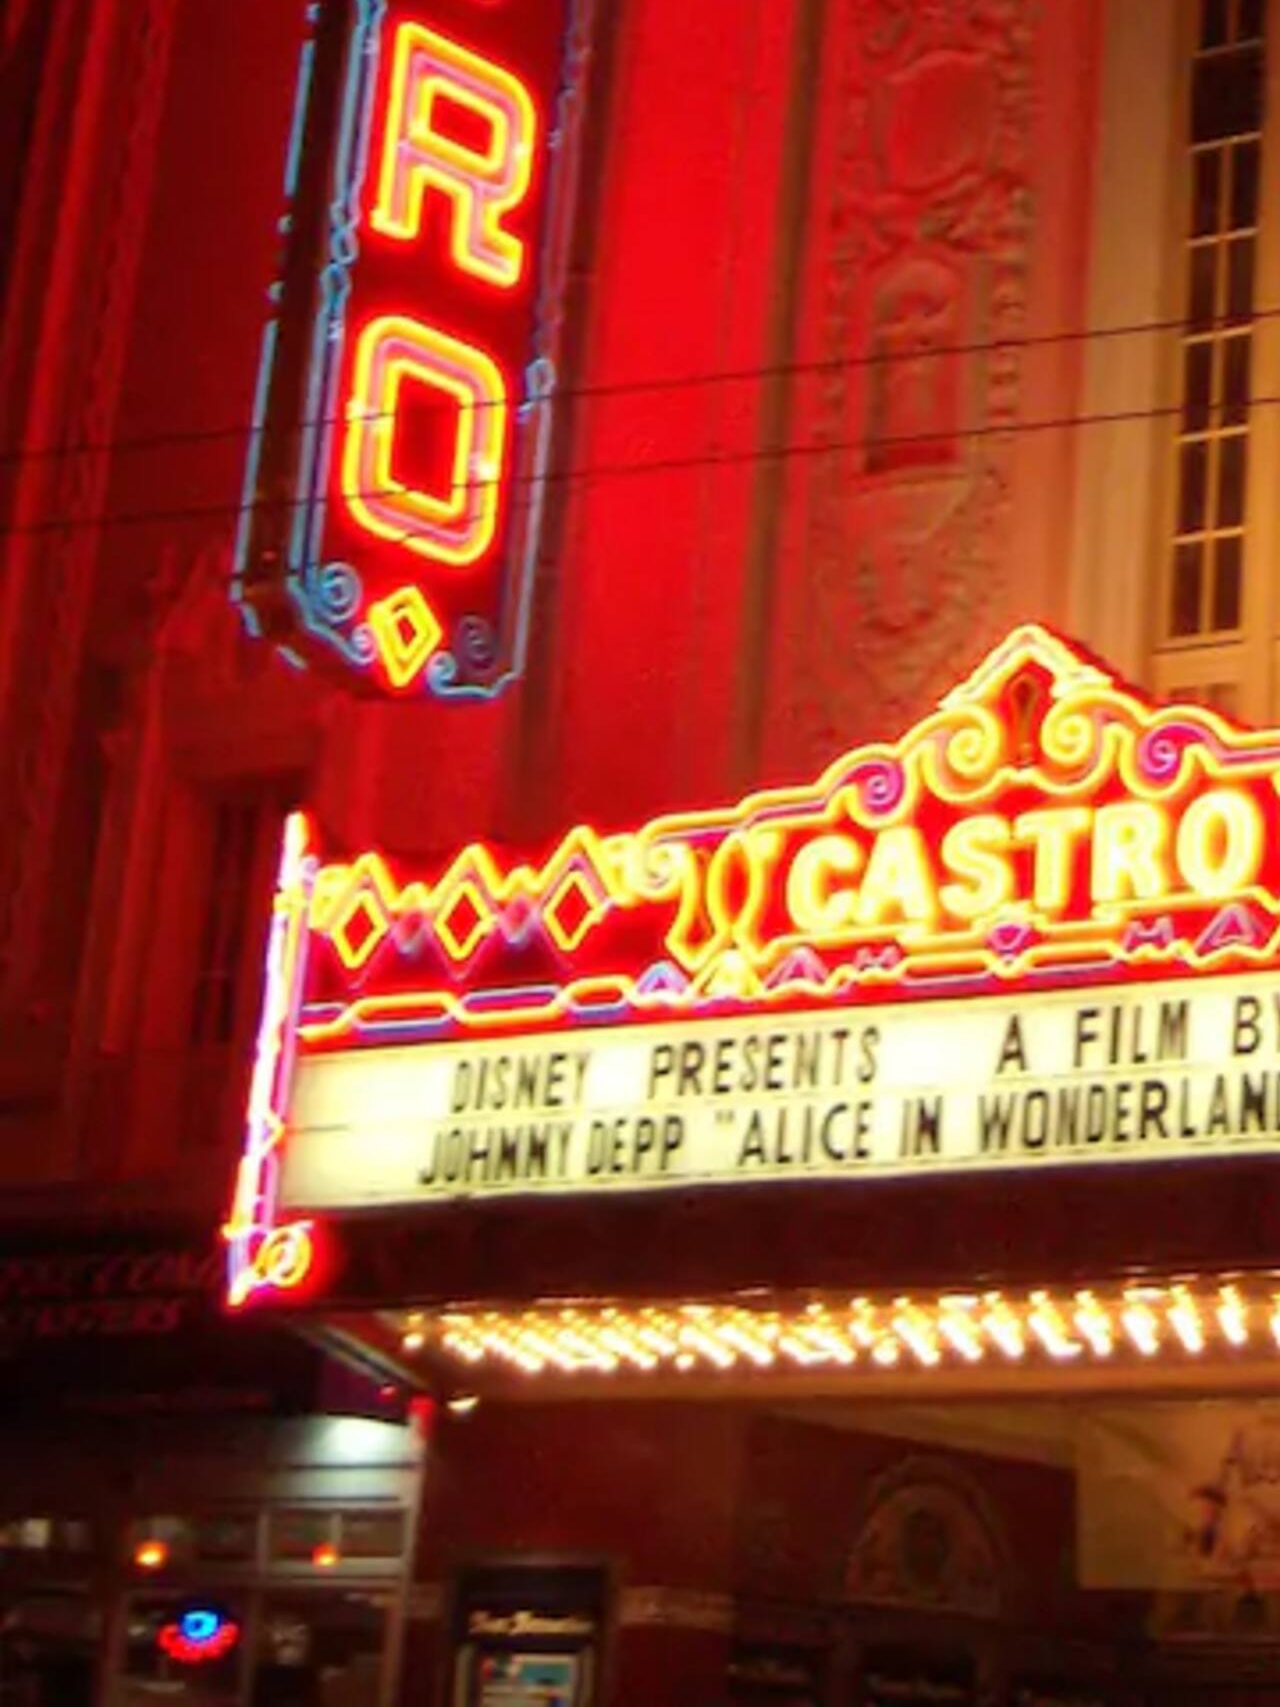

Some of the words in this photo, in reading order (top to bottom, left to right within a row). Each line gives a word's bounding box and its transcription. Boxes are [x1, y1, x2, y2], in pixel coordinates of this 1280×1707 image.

[785, 788, 1264, 932] CASTRO
[452, 1051, 591, 1114] DISNEY
[647, 1025, 881, 1099] PRESENTS
[996, 1013, 1027, 1072] A
[1072, 996, 1190, 1070] FILM
[420, 1120, 576, 1185] JOHNNY
[586, 1114, 686, 1176] DEPP
[899, 1094, 944, 1159] IN
